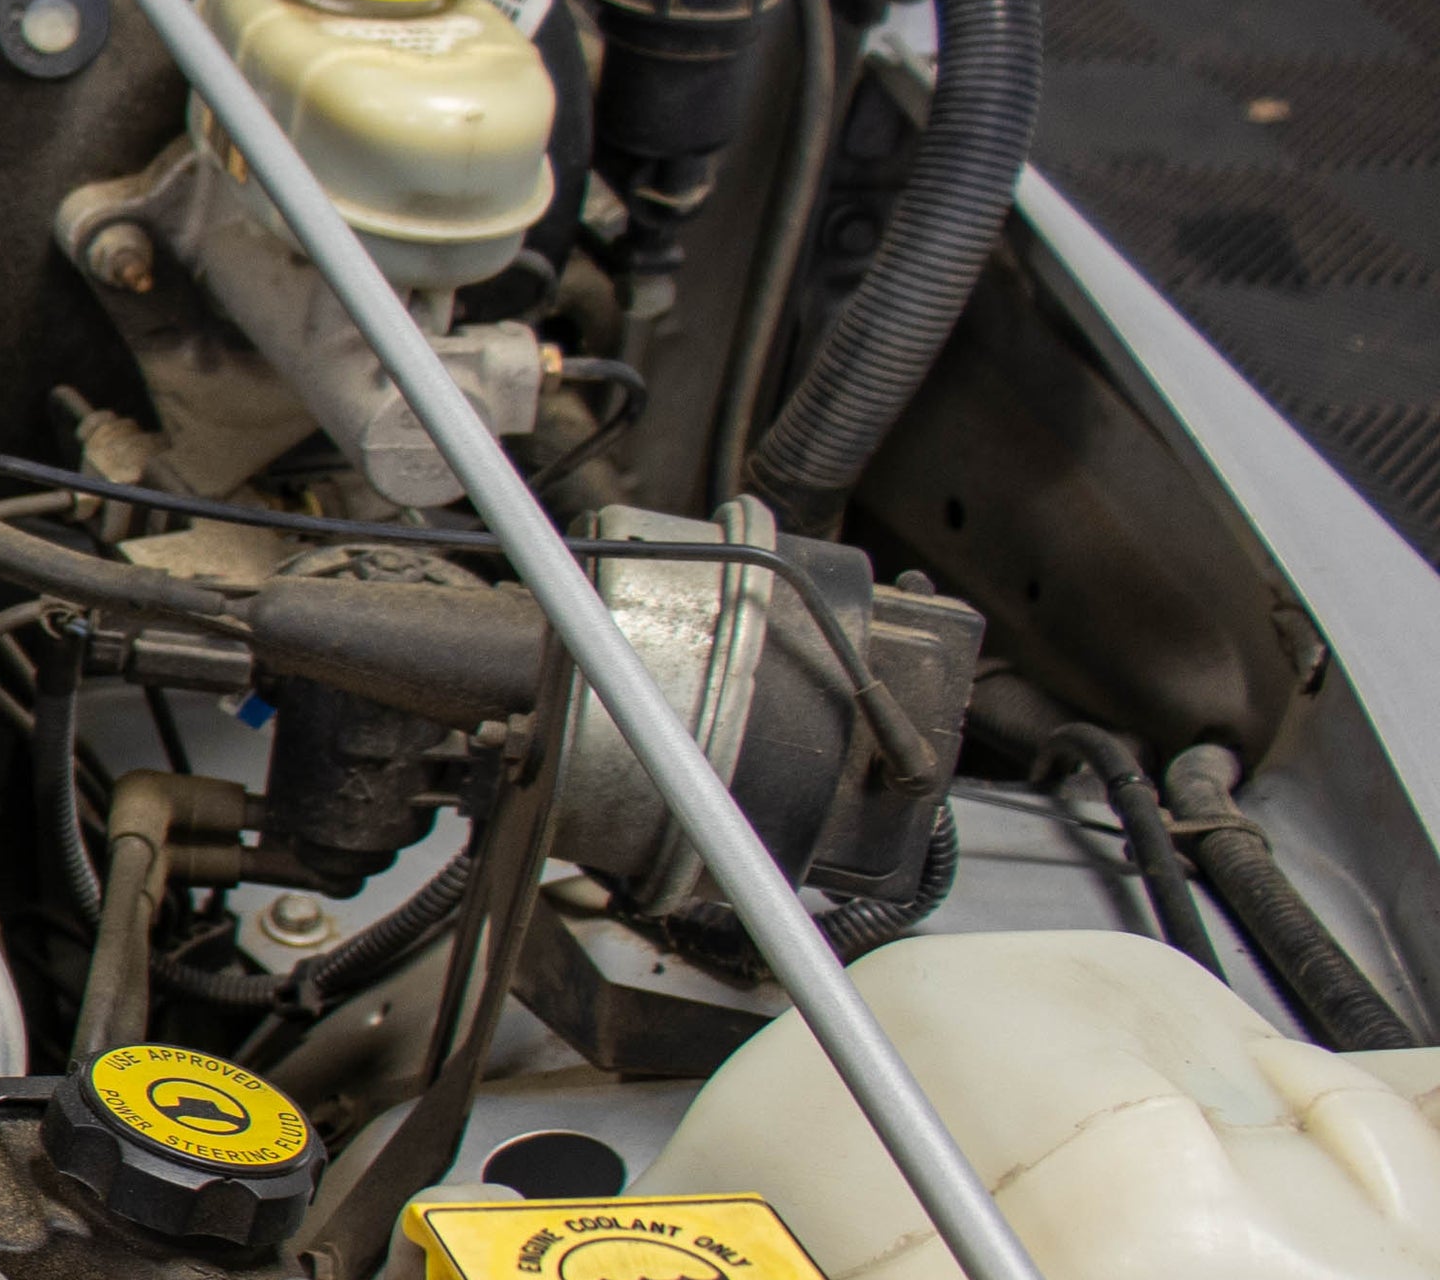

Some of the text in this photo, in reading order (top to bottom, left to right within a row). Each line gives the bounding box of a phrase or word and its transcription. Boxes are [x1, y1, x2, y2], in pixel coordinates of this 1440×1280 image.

[105, 1048, 264, 1091] USE APPROVED
[98, 1087, 304, 1163] POWER STEERING FLUID
[518, 1215, 752, 1274] ENGINE COOLANT ONLY
